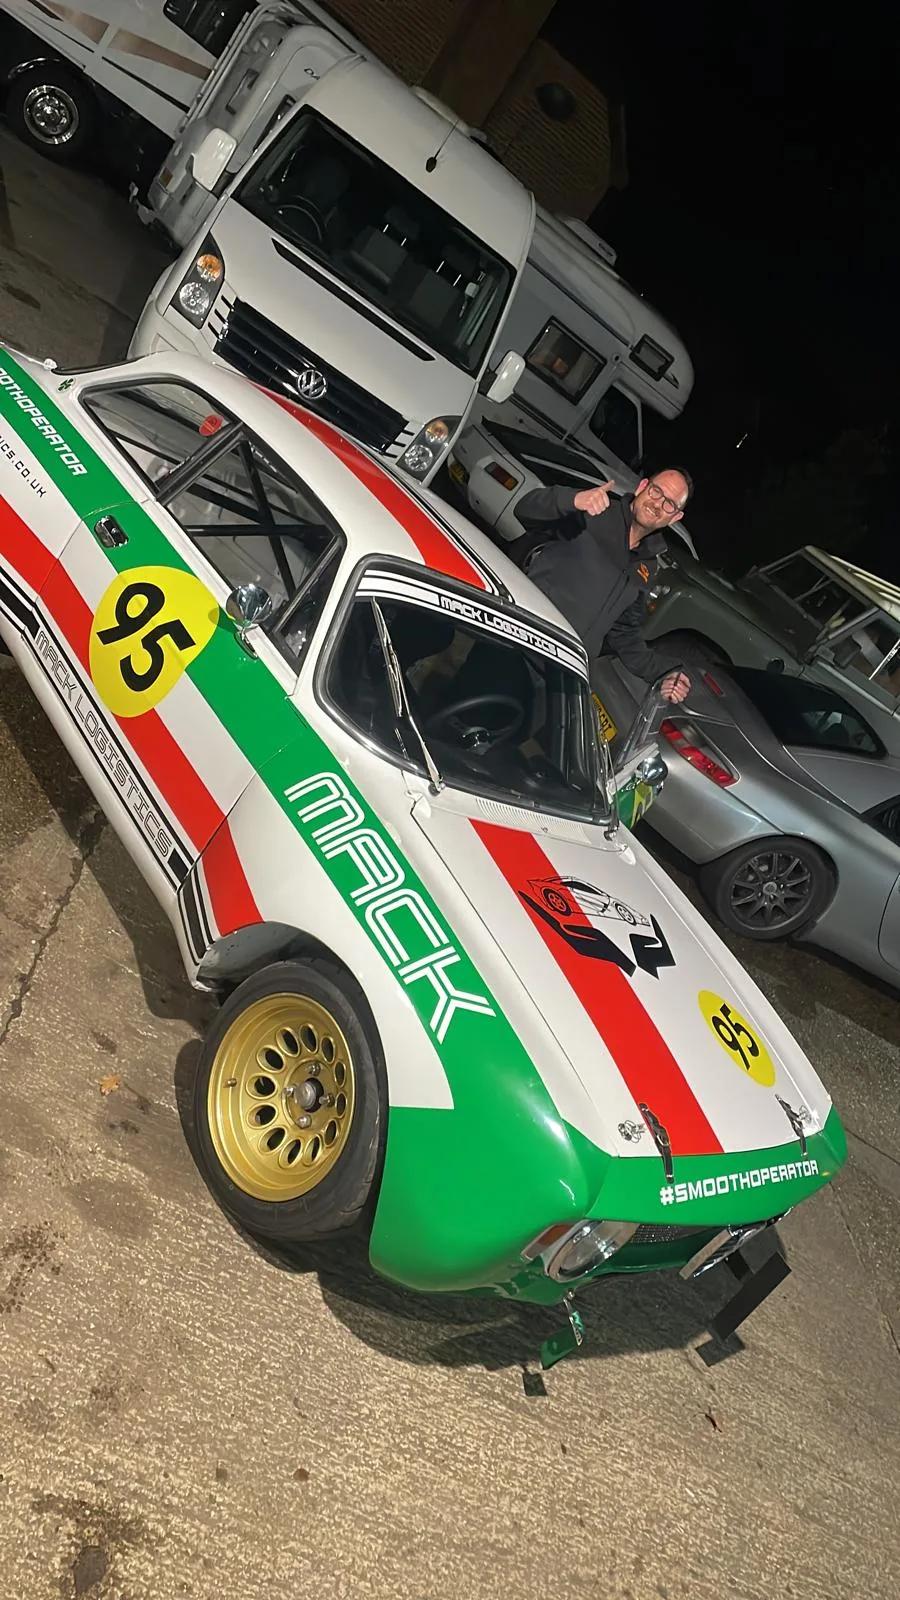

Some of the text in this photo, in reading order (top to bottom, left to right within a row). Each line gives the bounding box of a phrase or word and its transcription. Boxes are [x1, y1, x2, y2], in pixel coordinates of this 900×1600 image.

[0, 435, 47, 498] ICS.CO.UK
[96, 581, 197, 693] 95
[440, 596, 557, 656] MACK LOGISTICS
[36, 630, 173, 858] MACK LOGISTICS
[284, 771, 497, 1045] MACK
[711, 1002, 760, 1071] 95
[659, 1159, 819, 1206] #SMOOTHOPERATOR
